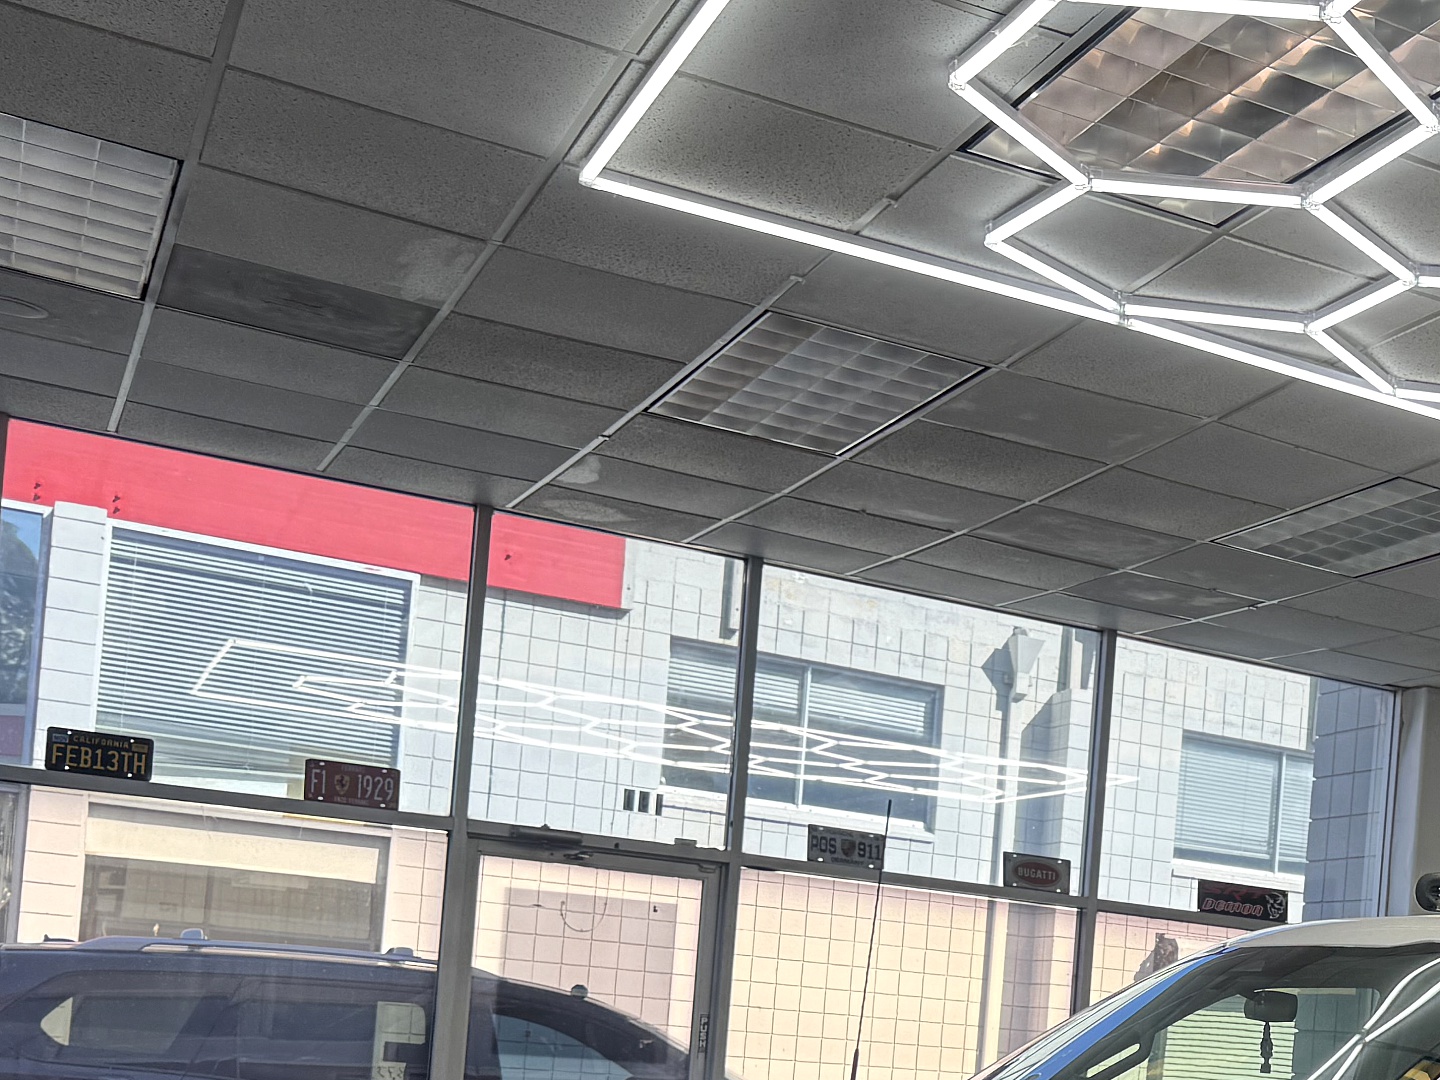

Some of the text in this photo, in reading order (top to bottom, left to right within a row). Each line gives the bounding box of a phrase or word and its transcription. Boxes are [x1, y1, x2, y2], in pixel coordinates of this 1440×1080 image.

[73, 734, 129, 749] CALIFORNIA
[51, 743, 146, 774] FEB13TH
[310, 768, 394, 801] F1 1929
[857, 841, 881, 861] 911
[1017, 866, 1057, 880] BUGATTI
[699, 1017, 708, 1048] PUSH
